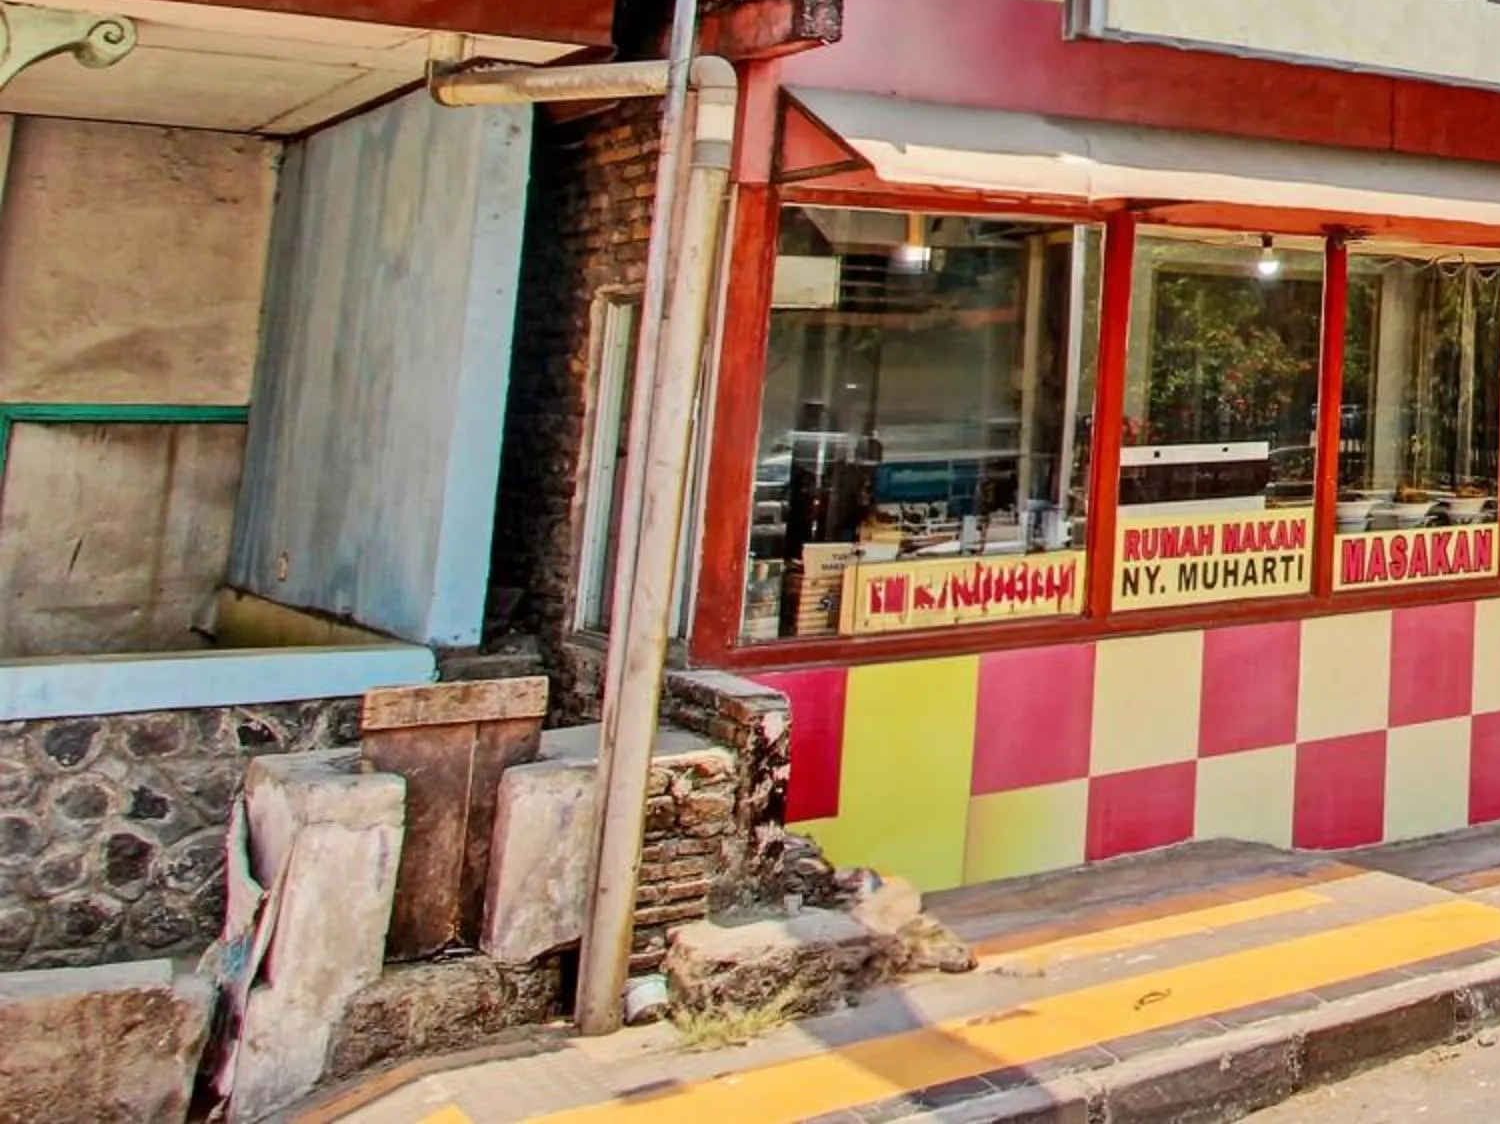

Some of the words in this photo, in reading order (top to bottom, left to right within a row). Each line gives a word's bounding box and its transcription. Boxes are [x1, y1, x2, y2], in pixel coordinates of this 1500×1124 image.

[1124, 525, 1215, 563] RUMAH
[1221, 519, 1306, 555] MAKAN
[1340, 528, 1493, 585] MASAKAN
[1121, 565, 1165, 598] NY.
[1177, 553, 1305, 592] MUHARTI
